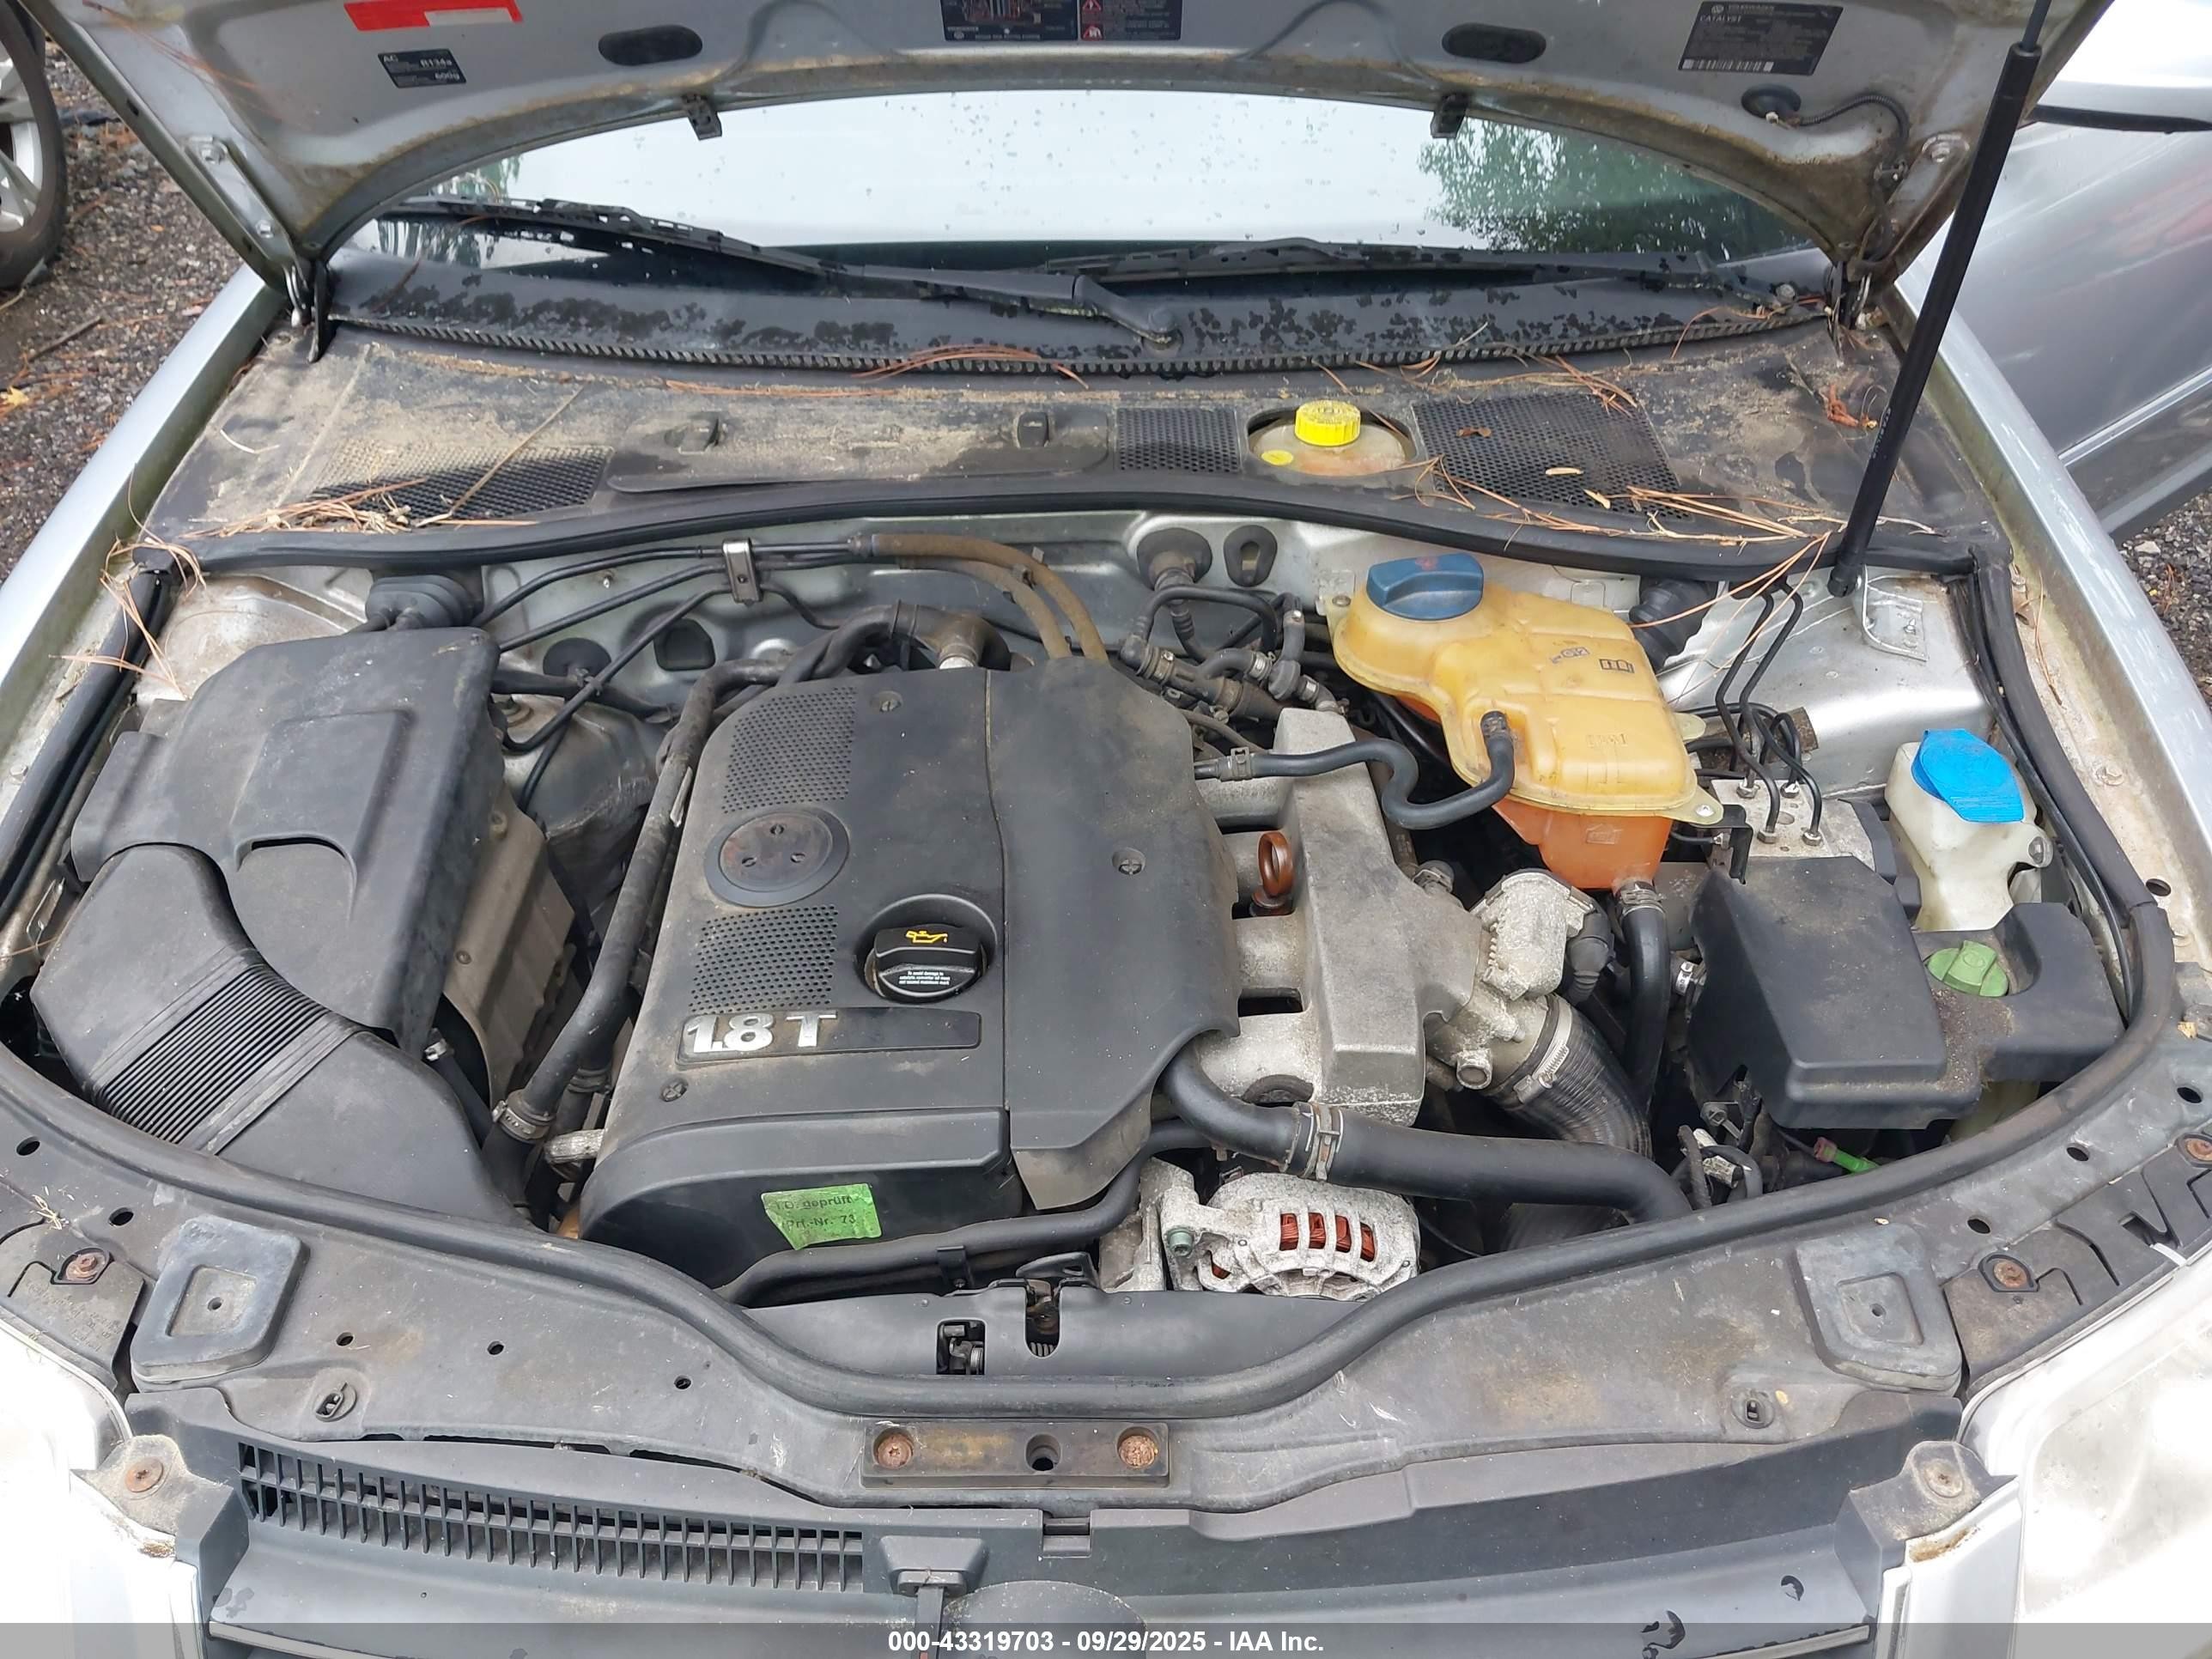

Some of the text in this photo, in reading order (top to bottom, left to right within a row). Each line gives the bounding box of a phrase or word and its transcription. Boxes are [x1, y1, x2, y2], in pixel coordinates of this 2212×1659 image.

[1699, 15, 1742, 23] CATALYST
[786, 1010, 837, 1048] T
[841, 1213, 857, 1224] 73
